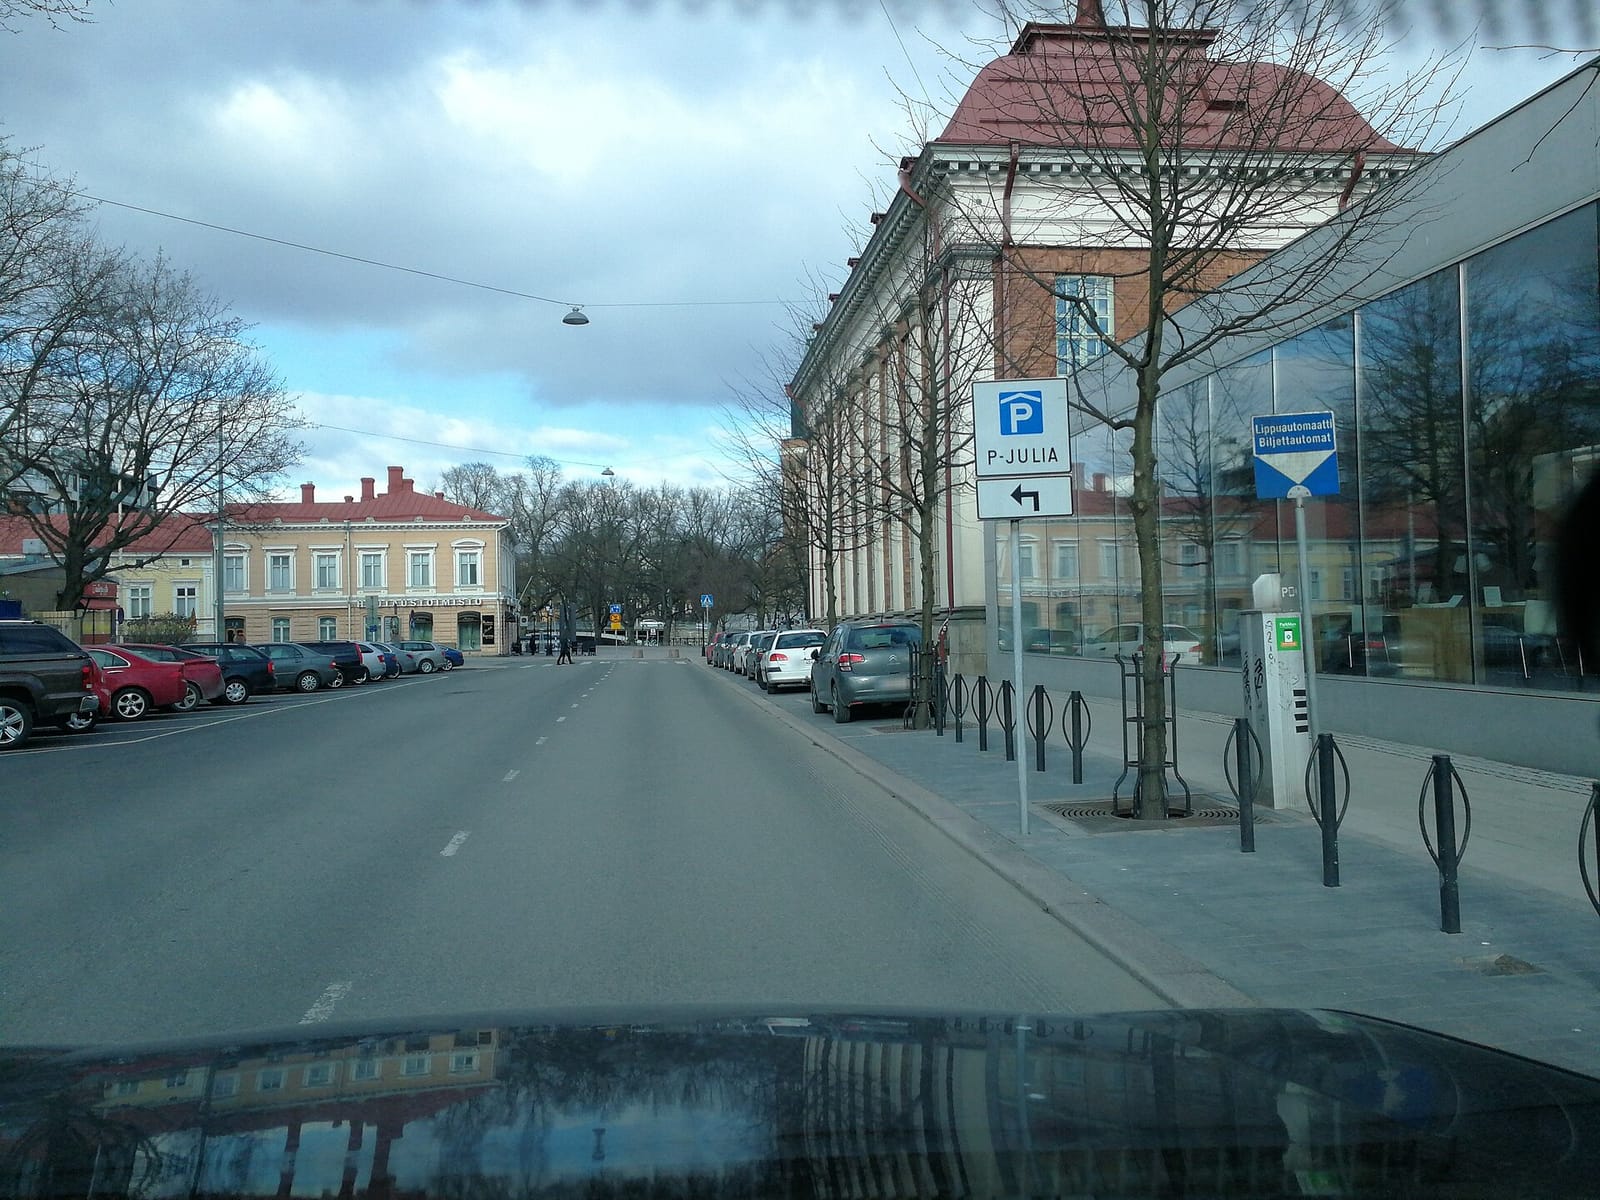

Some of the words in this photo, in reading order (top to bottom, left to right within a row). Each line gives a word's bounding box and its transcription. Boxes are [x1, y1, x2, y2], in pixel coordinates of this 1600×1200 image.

[1255, 418, 1333, 436] Lippuautomaatti
[1259, 433, 1332, 448] Biljettautomat
[987, 447, 1058, 465] P-JULIA
